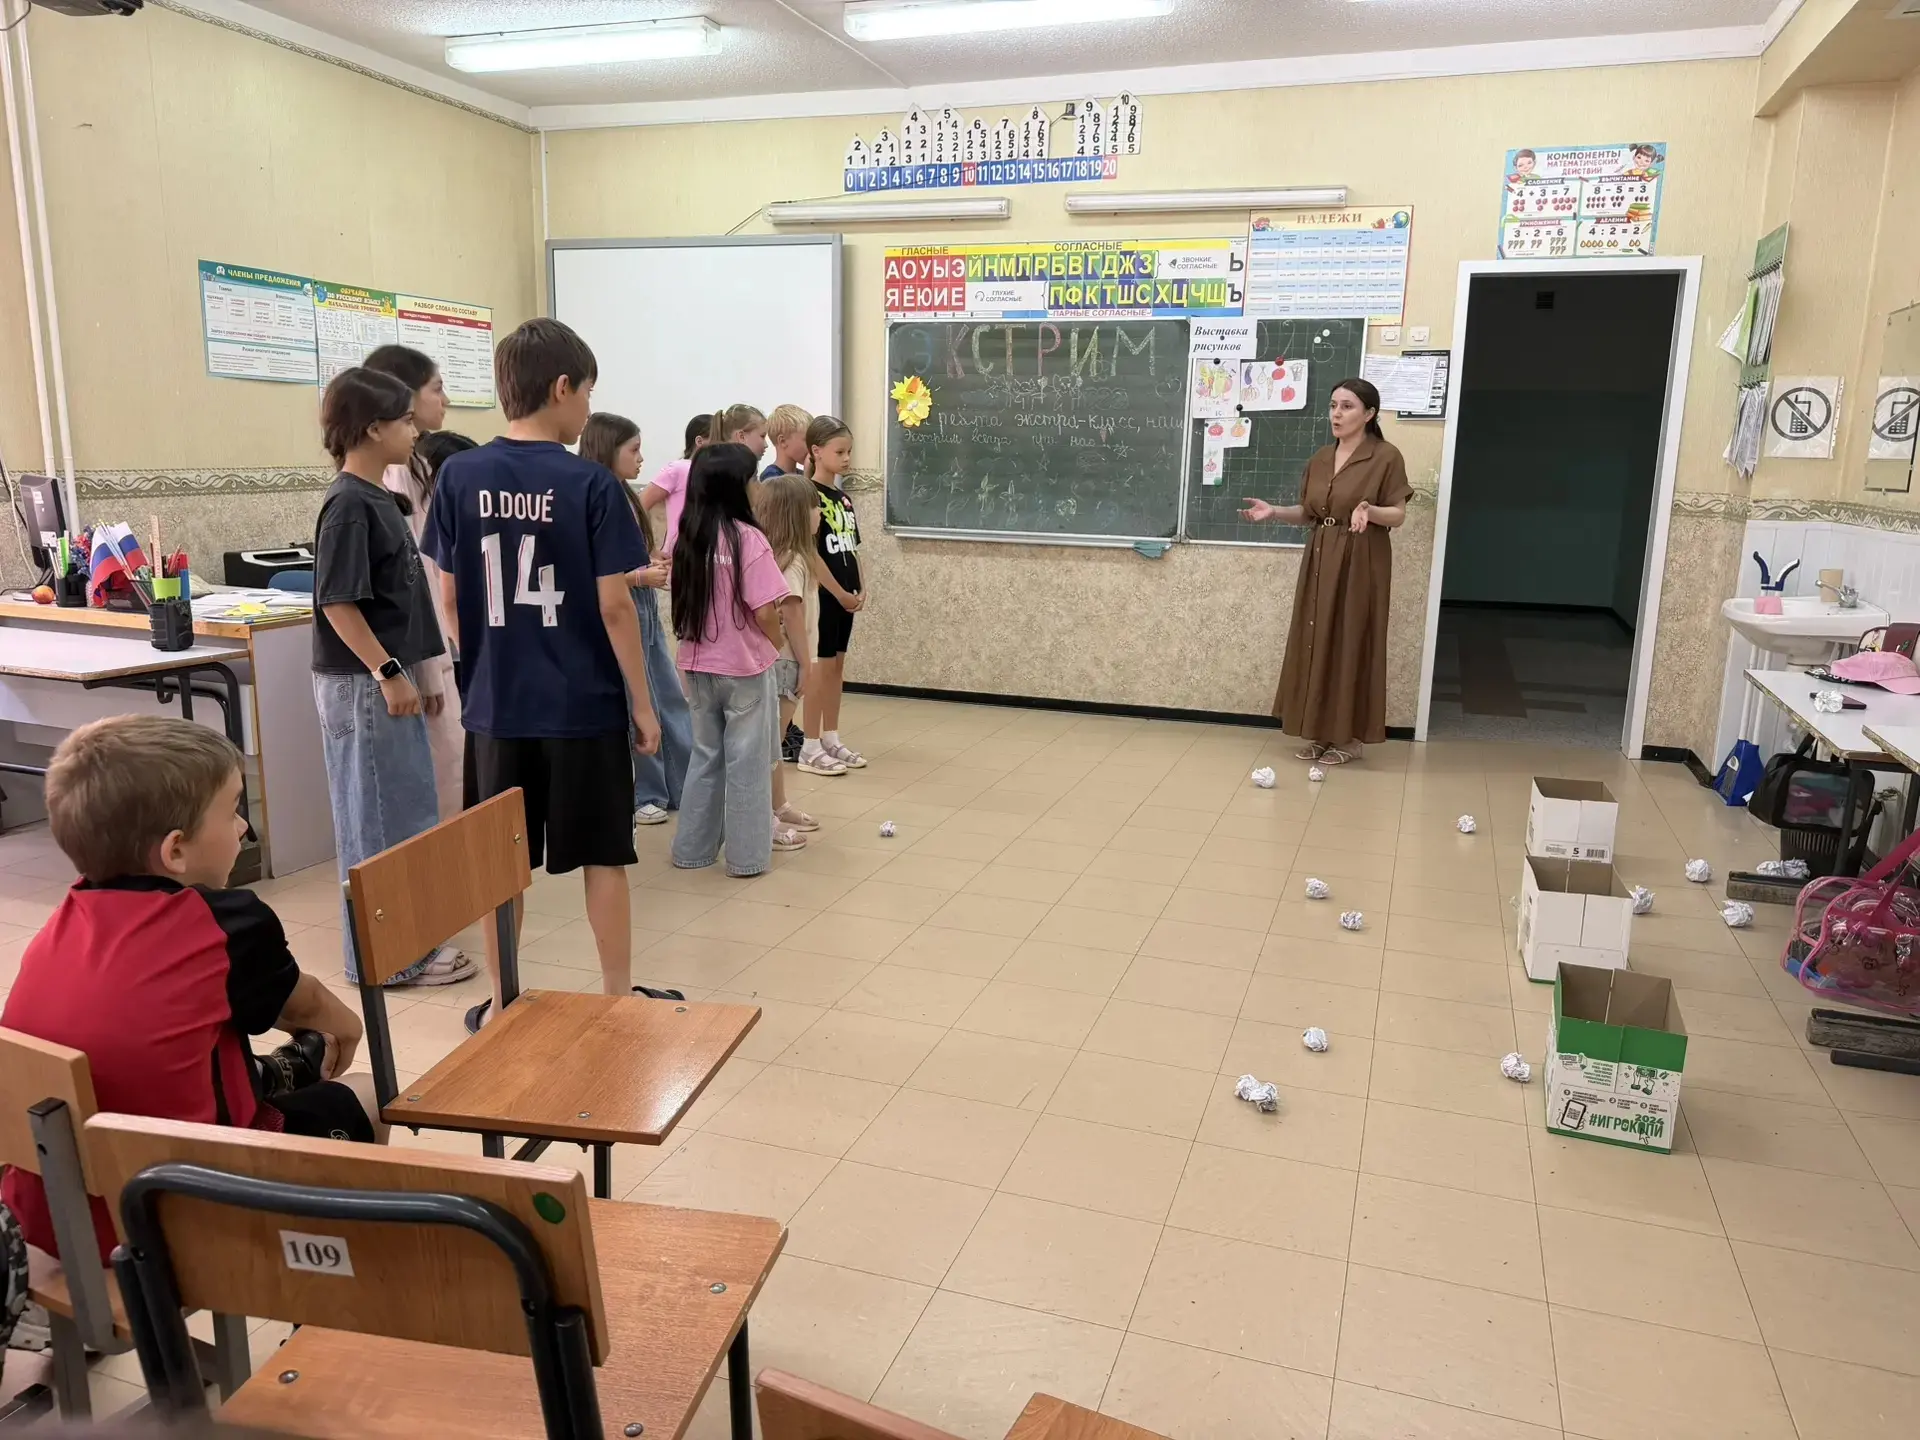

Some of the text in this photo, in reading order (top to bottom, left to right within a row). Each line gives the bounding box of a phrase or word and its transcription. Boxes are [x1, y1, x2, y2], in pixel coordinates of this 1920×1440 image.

[1547, 150, 1621, 160] КОМПОНЕНТЫ
[1547, 158, 1619, 167] МАТЕМАТИЧЕСКИХ
[846, 159, 1116, 188] 0 1 2 3 4 5 6 7 8 9 10 11 12 13 14 15 16 17 18 19 20
[1297, 212, 1362, 224] ПАДЕЖИ
[901, 246, 949, 256] ГЛАСНЫЕ
[1054, 241, 1122, 252] СОГЛАСНЫЕ
[227, 268, 302, 287] ЧЛЕНЫ ПРЕДЛОЖЕНИЯ
[414, 301, 434, 309] РАЗБОР
[435, 304, 451, 312] СЛОВА
[1092, 309, 1148, 317] СОГЛАСНЫЕ
[1194, 326, 1249, 336] Выставка
[911, 322, 1156, 378] ЭКСТРИМ
[1193, 342, 1242, 353] рисунков
[479, 489, 554, 522] D.DOUÉ
[480, 533, 565, 627] 14
[1634, 1113, 1664, 1125] 2024
[286, 1240, 341, 1267] 109
